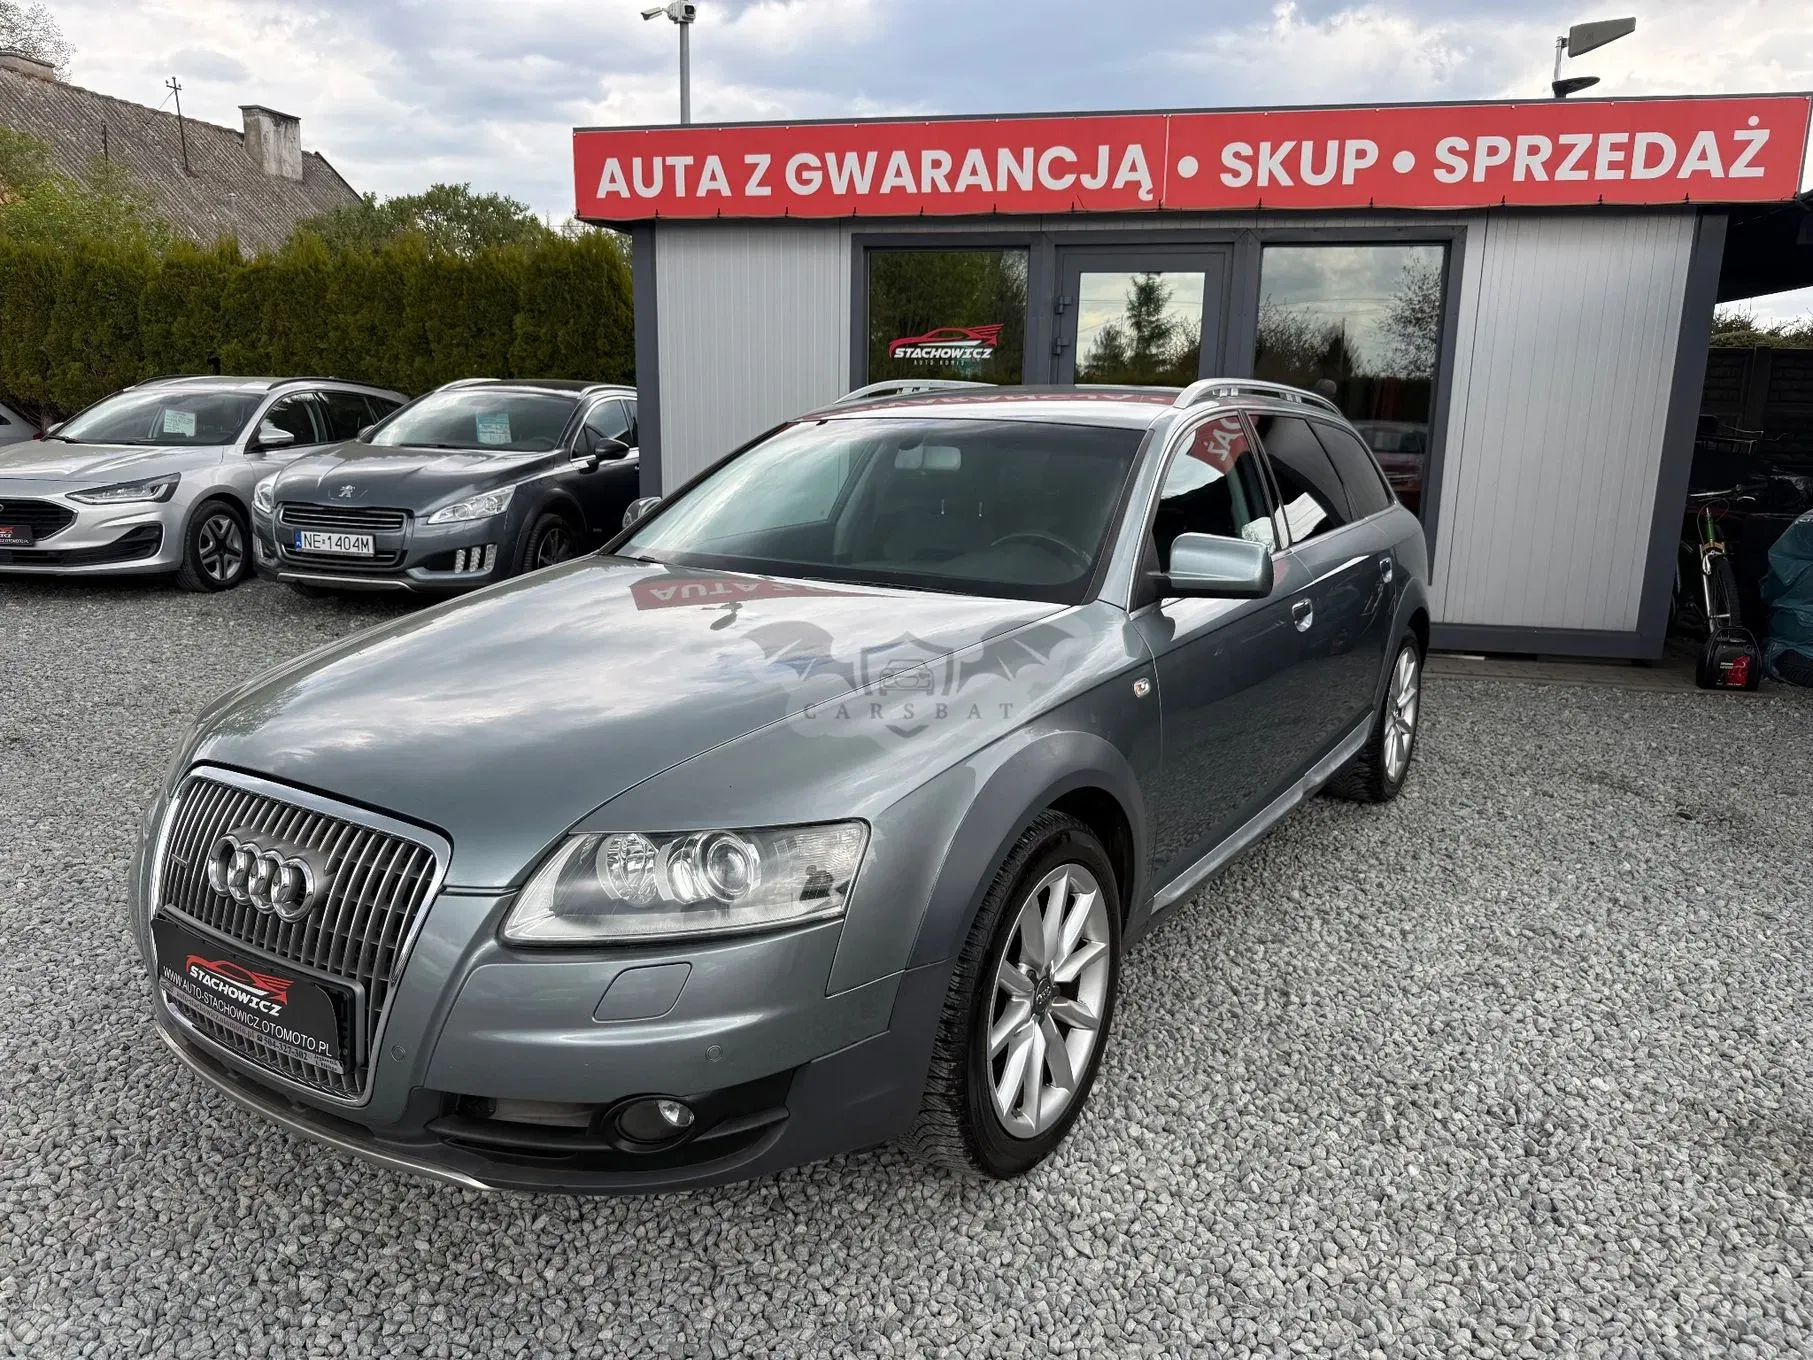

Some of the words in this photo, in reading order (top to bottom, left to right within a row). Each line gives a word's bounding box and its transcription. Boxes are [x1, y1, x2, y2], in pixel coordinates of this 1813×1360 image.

[595, 155, 732, 199] AUTA
[744, 154, 772, 197] Z
[785, 144, 1153, 201] GWARANCJĄ
[1219, 140, 1379, 188] SKUP
[1433, 115, 1770, 184] SPRZEDAŻ
[894, 347, 993, 359] STACHOWICZ
[303, 533, 321, 549] NE
[327, 535, 370, 552] 1404M
[163, 965, 332, 1057] WWW.AUTO-STACHOWICZ.OTOMOTO.PL
[190, 965, 282, 1016] STACHOWICZ
